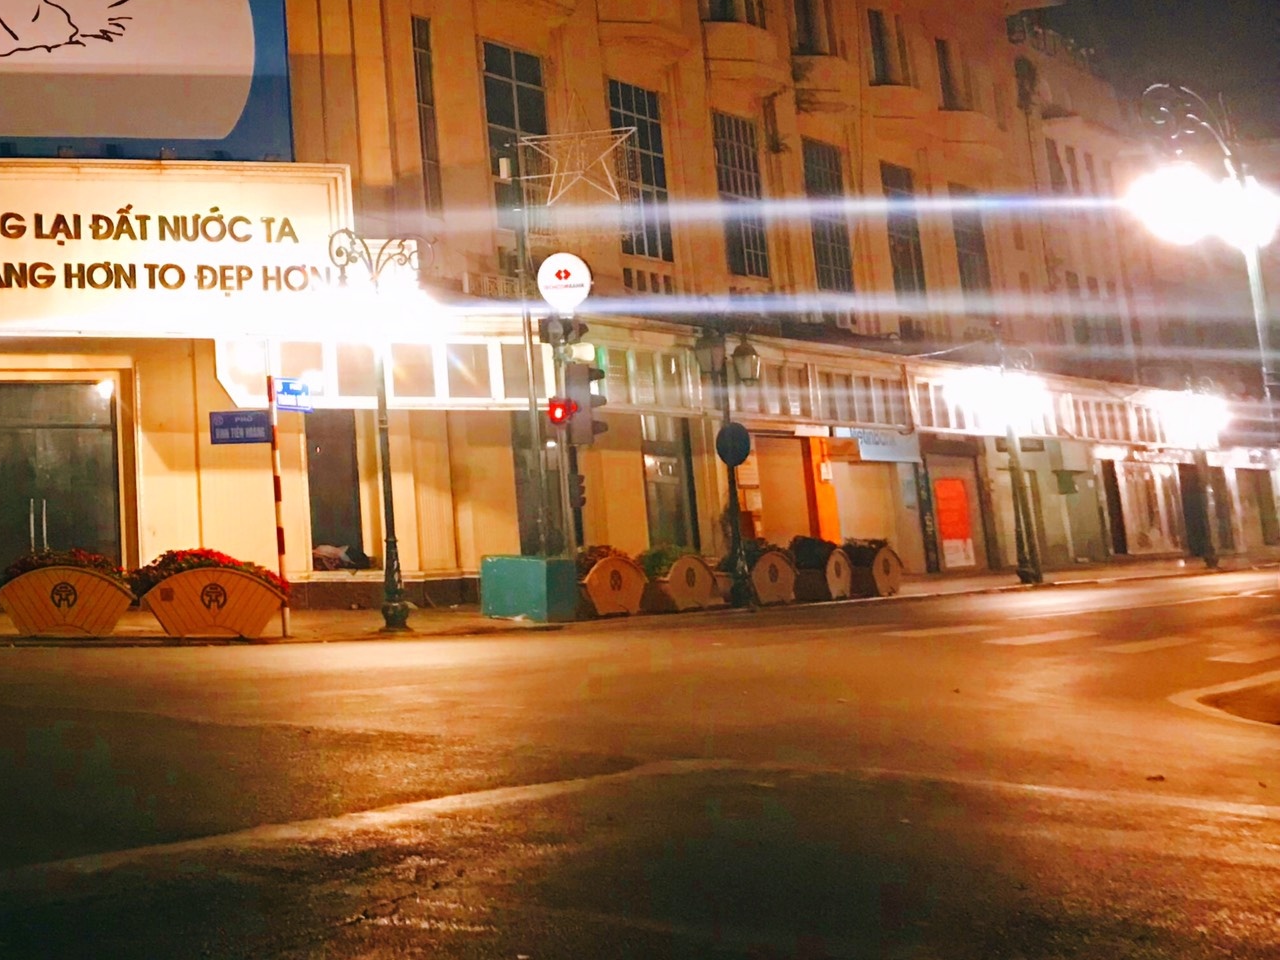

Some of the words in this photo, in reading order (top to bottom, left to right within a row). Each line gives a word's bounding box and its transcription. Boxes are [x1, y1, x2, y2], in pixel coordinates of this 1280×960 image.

[34, 212, 82, 246] LẠI
[89, 203, 151, 241] ĐẤT
[158, 206, 252, 243] NƯỚC
[260, 216, 299, 244] TA
[63, 261, 137, 290] HƠN
[144, 262, 186, 290] TO
[194, 264, 253, 297] ĐẸP
